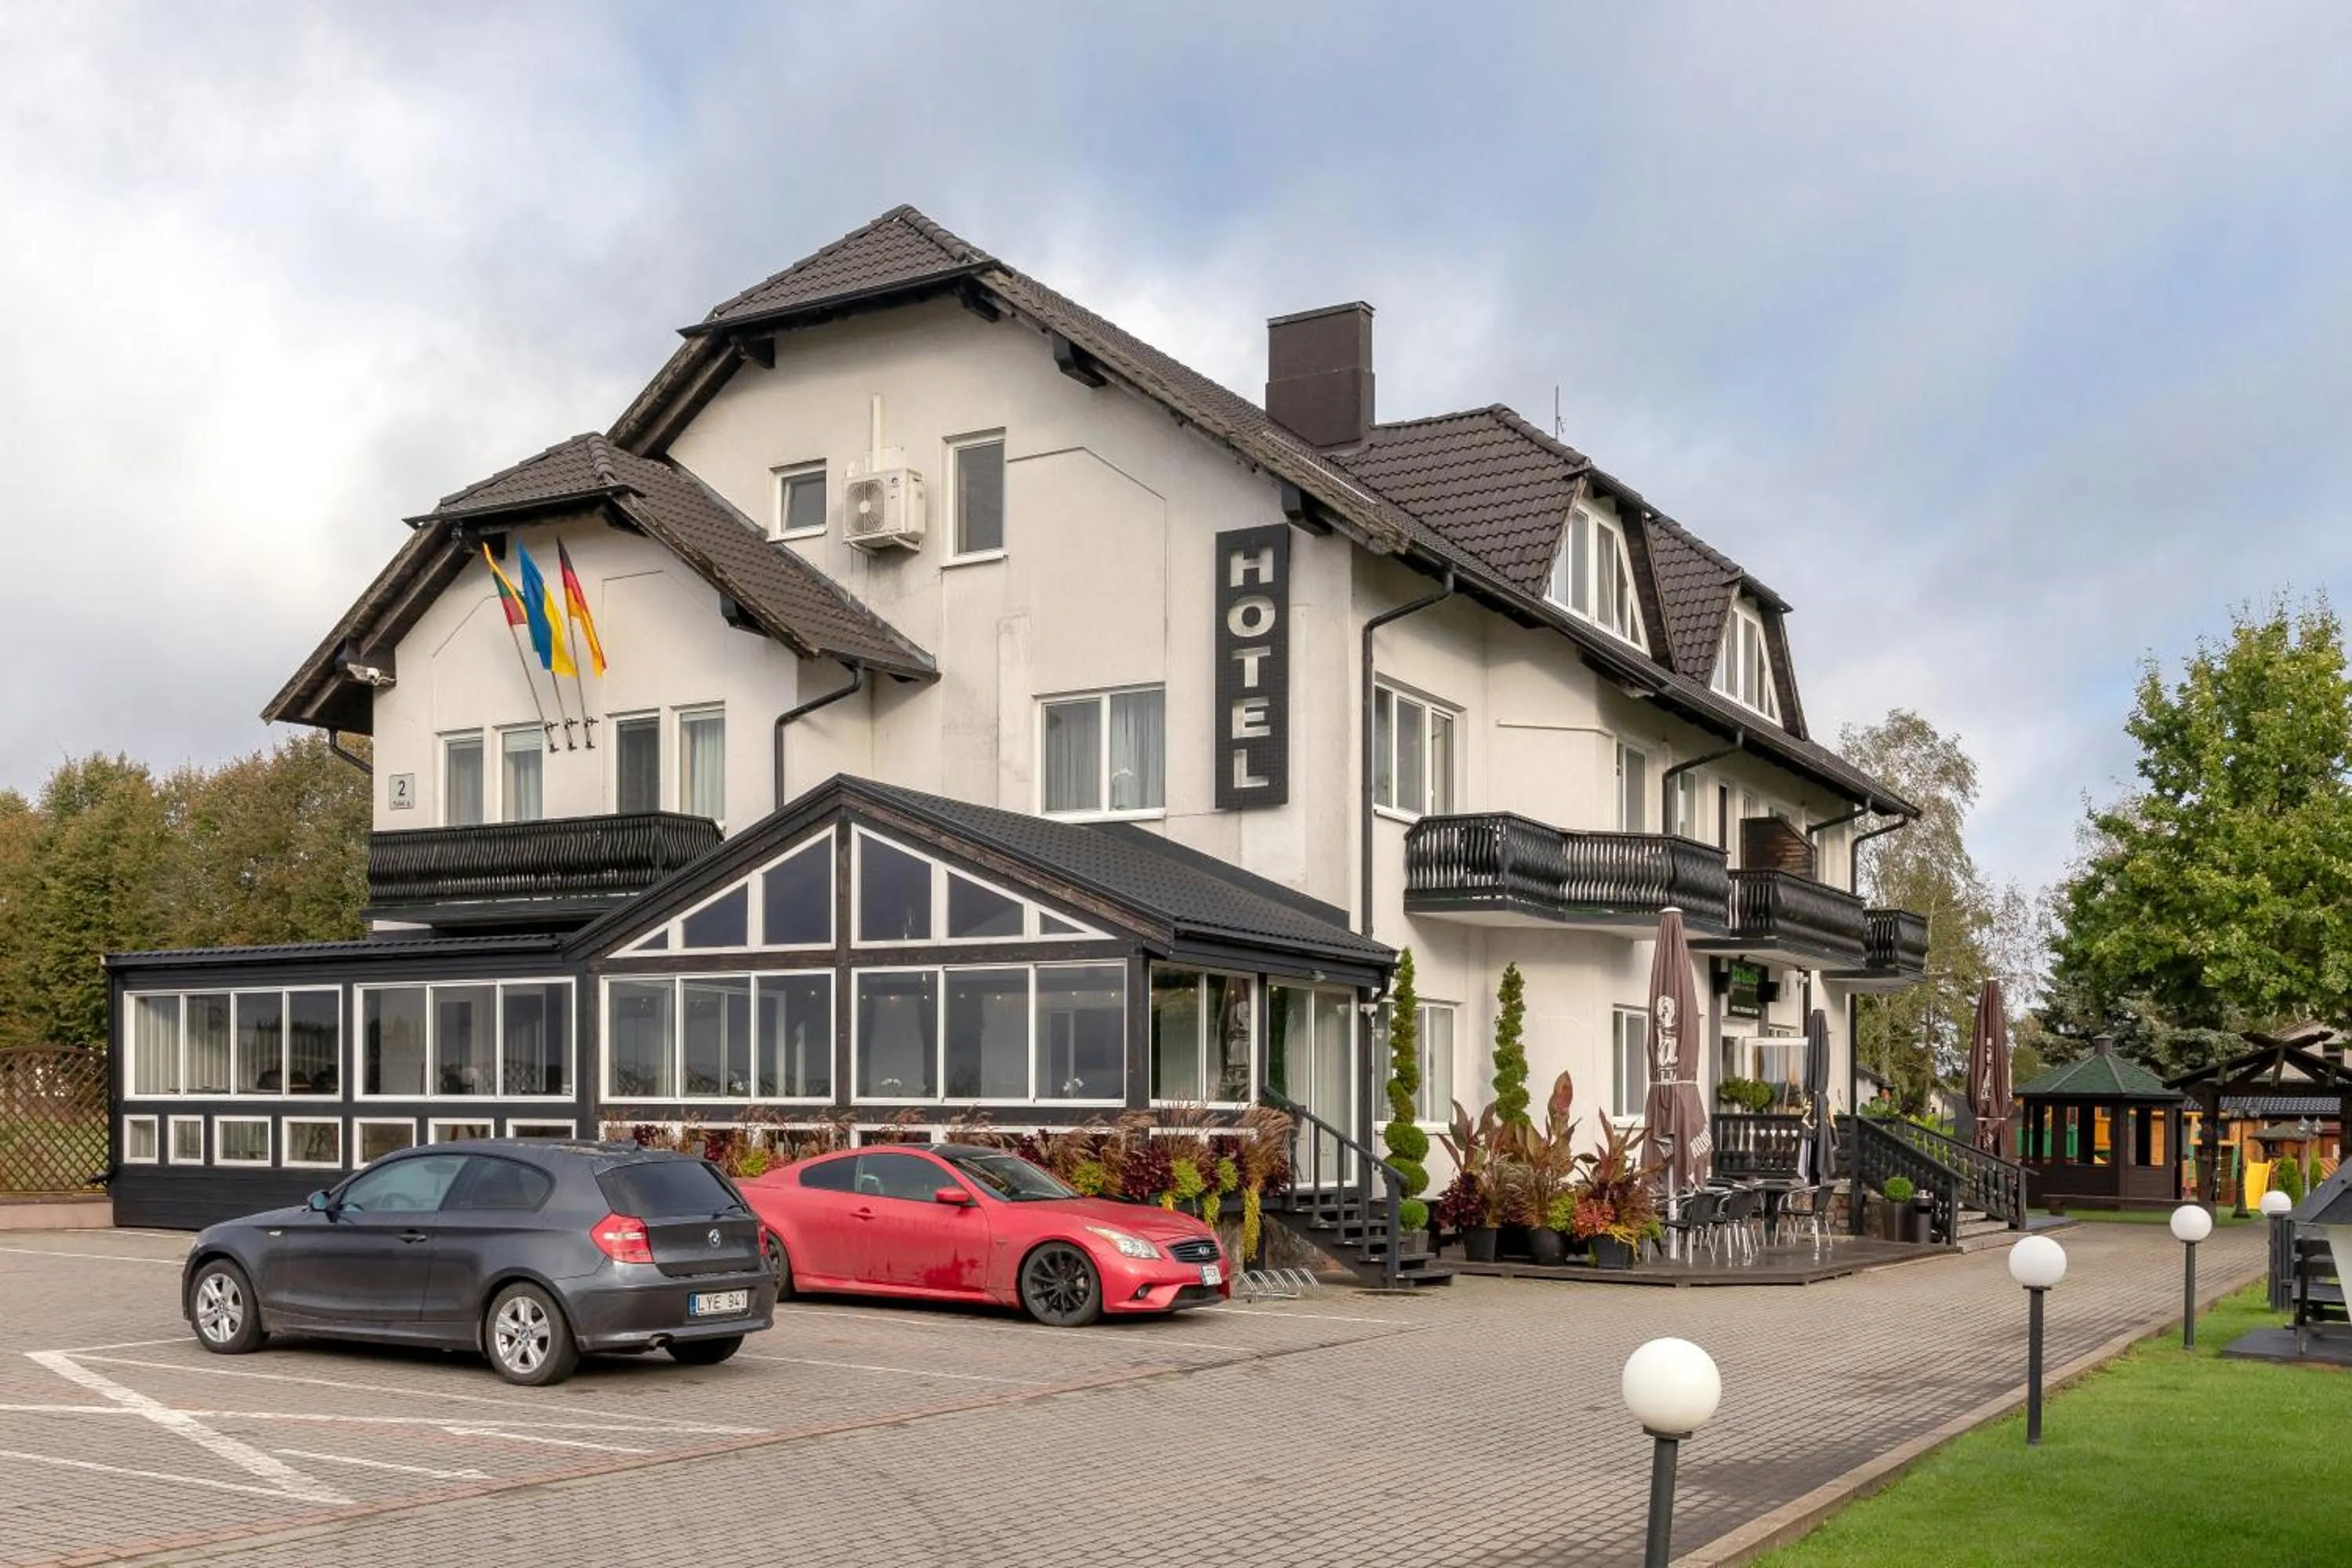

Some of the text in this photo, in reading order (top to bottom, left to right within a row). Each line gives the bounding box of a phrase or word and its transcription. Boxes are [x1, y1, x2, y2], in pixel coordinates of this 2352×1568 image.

[1227, 546, 1276, 789] HOTEL
[398, 779, 406, 797] 2
[698, 1292, 746, 1311] LYE 941
